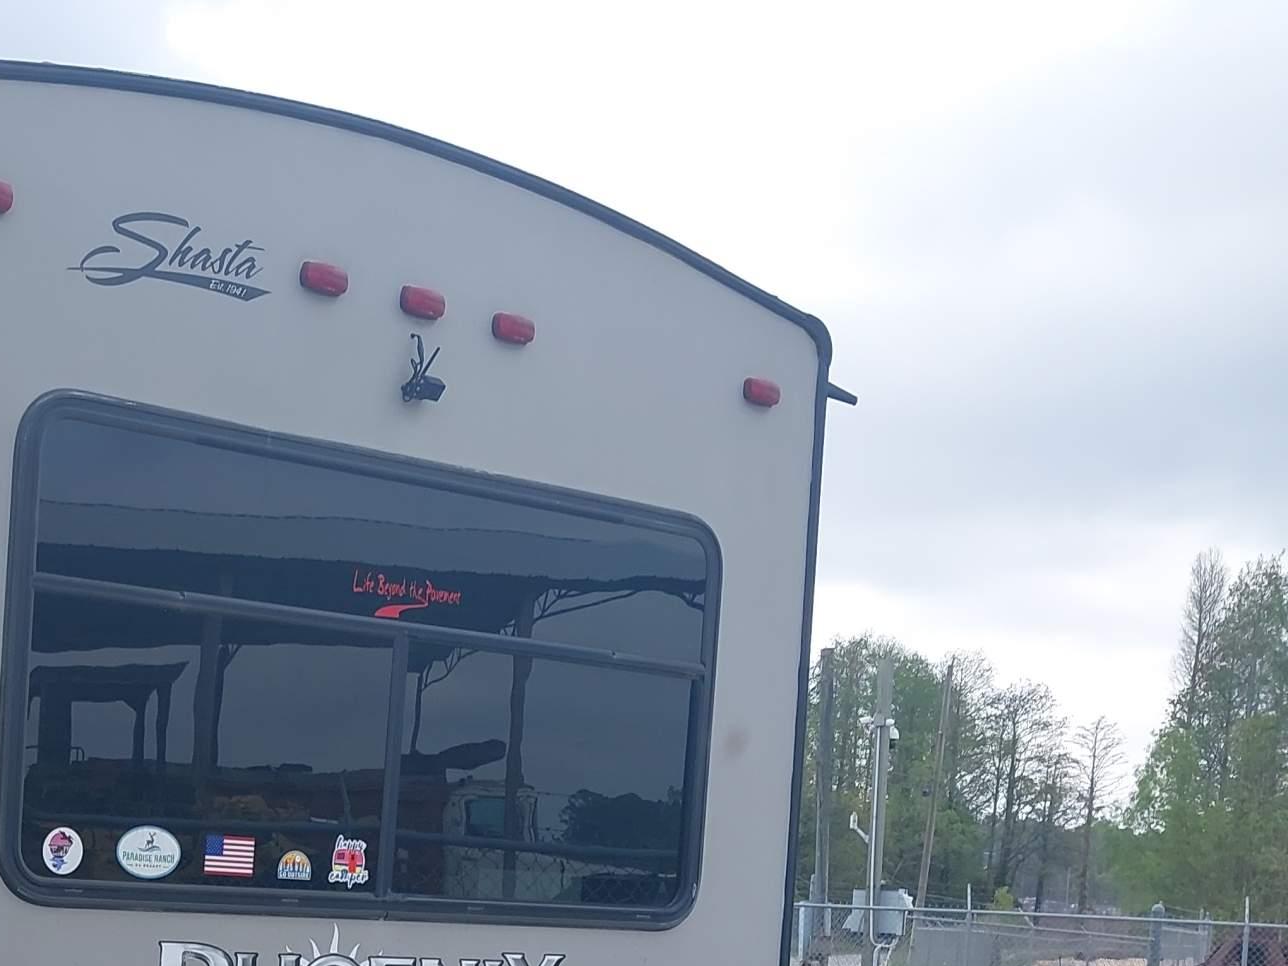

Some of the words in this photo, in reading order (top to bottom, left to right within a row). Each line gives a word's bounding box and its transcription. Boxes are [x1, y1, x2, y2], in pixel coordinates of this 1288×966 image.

[70, 212, 267, 287] Shasta
[353, 570, 374, 593] Life
[377, 574, 406, 600] Beyond
[409, 580, 424, 599] the
[122, 851, 152, 862] PARADISE
[154, 854, 175, 863] RANCH
